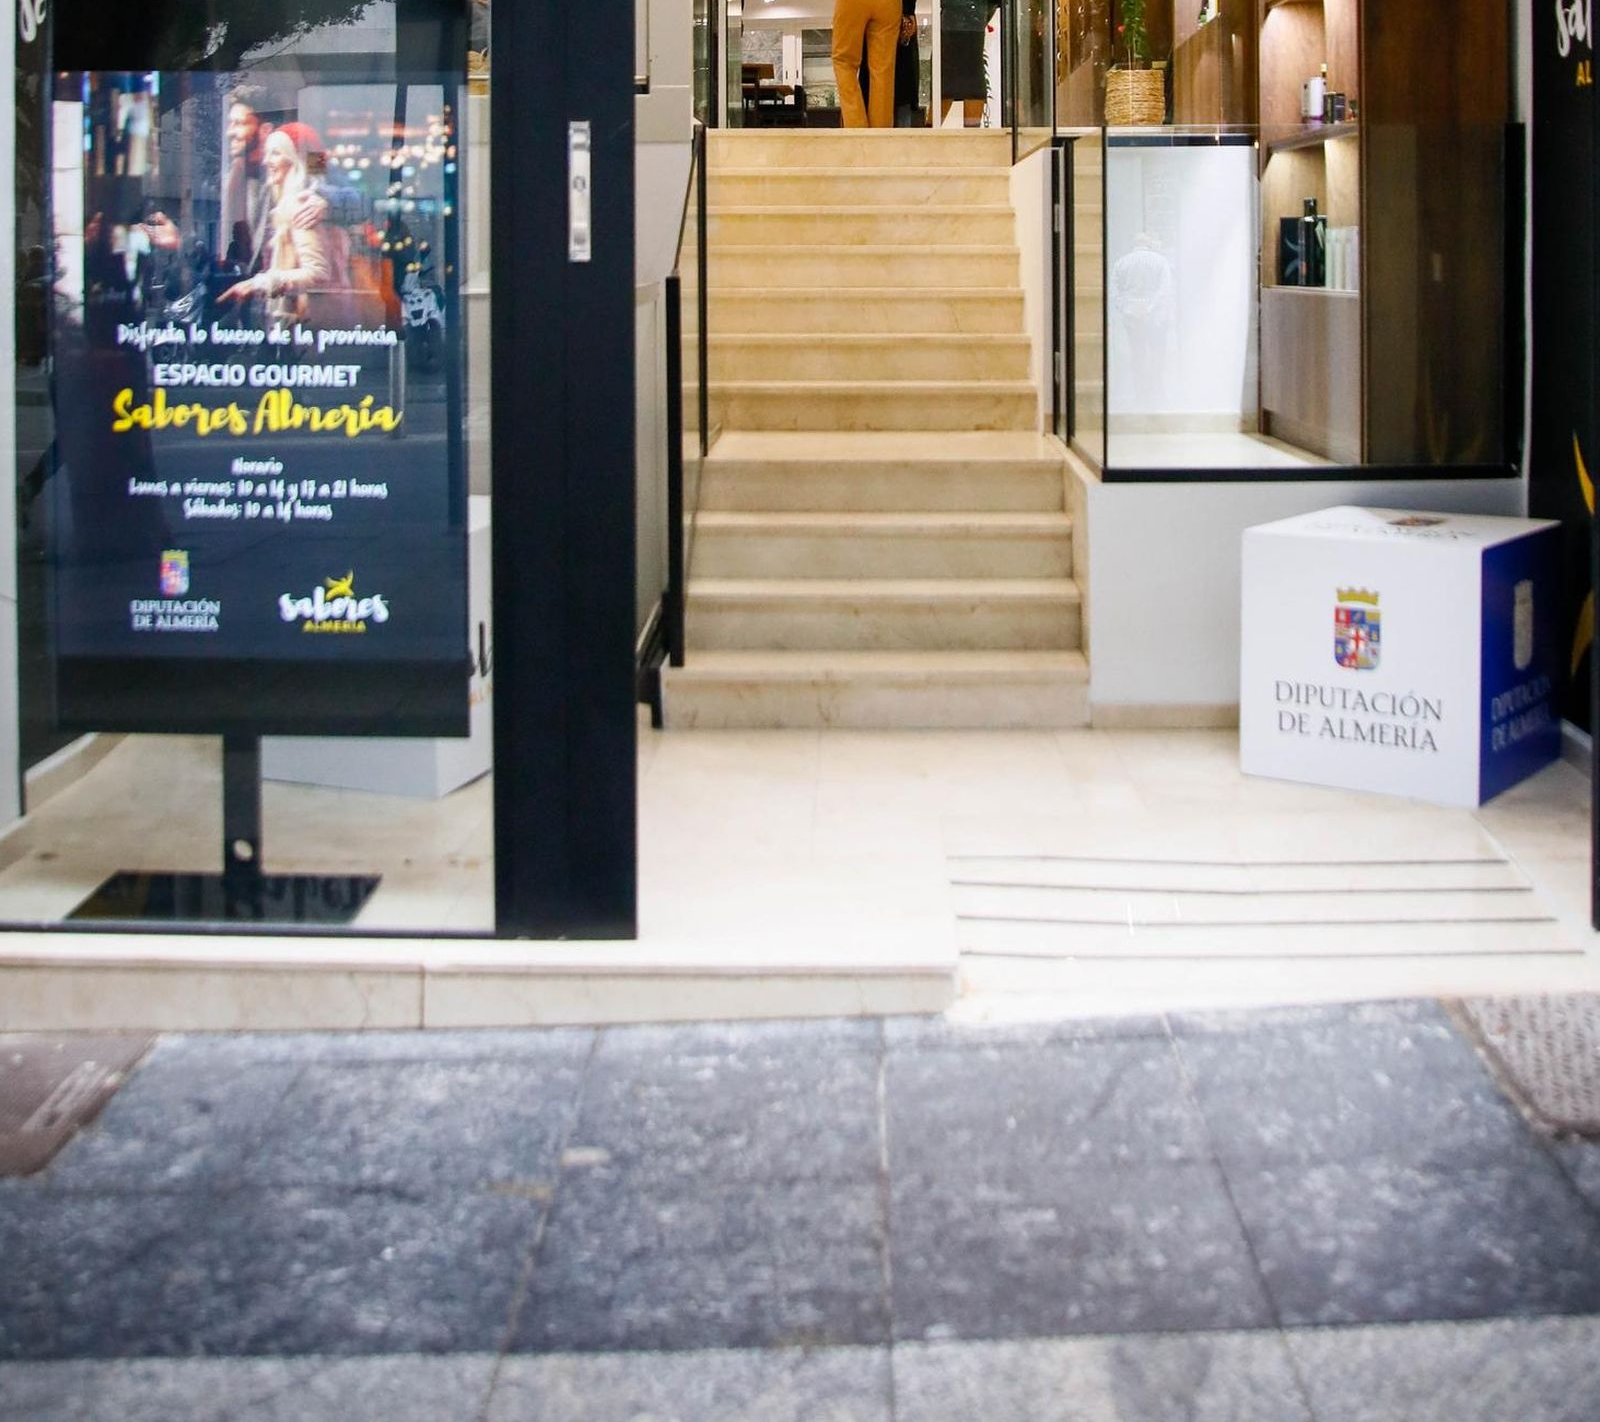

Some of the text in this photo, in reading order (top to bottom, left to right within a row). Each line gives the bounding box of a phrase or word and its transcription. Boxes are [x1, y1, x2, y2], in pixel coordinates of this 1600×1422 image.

[117, 321, 398, 353] Disfruta lo bueno de la provincia
[153, 363, 361, 387] ESPACIO GOURMET
[112, 387, 403, 438] Sabores Almería
[231, 457, 283, 476] Horario
[128, 477, 168, 497] Lunes
[169, 482, 181, 496] a
[255, 483, 267, 497] a
[318, 483, 330, 497] a
[349, 478, 388, 499] horas
[262, 504, 274, 518] a
[294, 499, 333, 521] horas
[131, 598, 221, 616] DIPUTACIÓN
[279, 586, 389, 623] sabores
[133, 614, 154, 631] DE
[1275, 679, 1443, 722] DIPUTACIÓN
[1277, 710, 1439, 752] DE ALMERÍA
